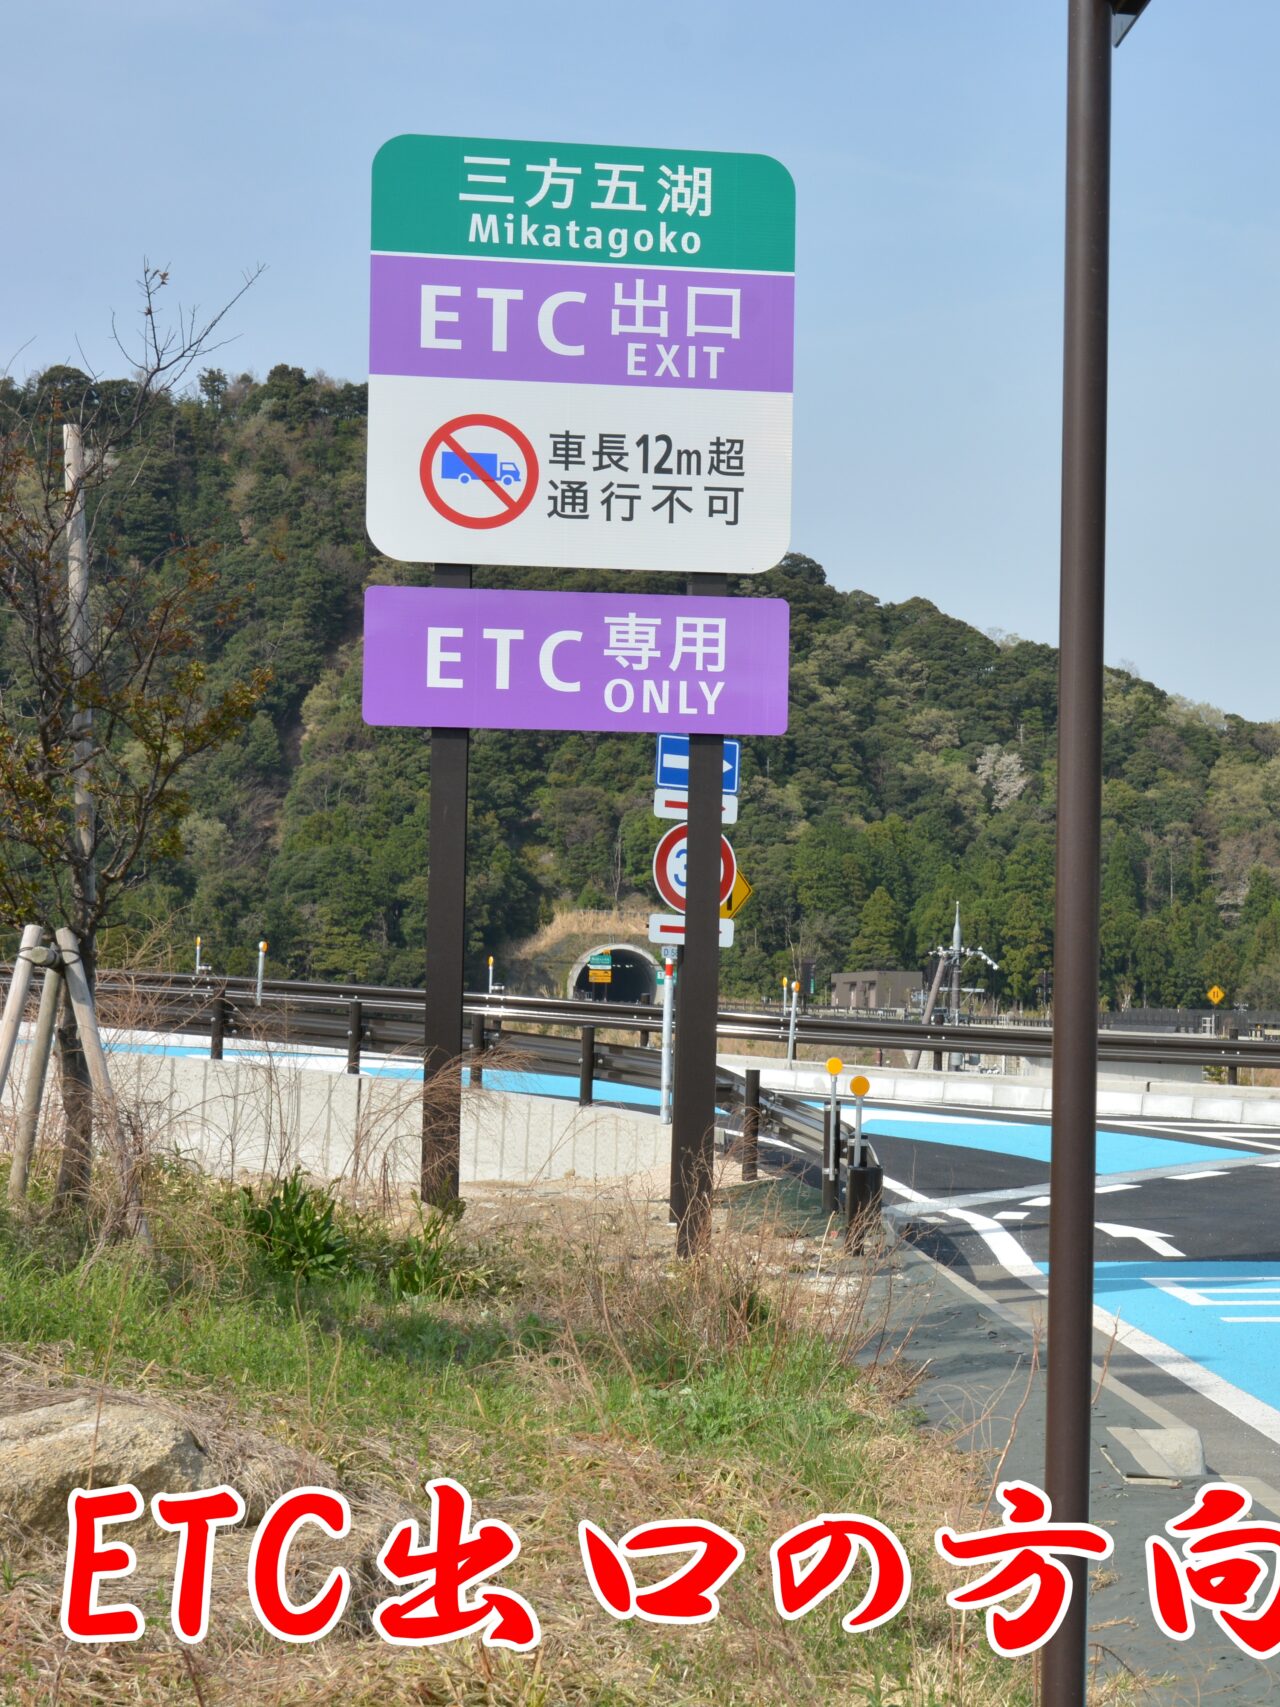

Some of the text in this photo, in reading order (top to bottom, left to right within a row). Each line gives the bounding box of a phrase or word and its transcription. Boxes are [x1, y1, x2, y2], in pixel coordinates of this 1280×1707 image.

[459, 156, 712, 217] 三方五湖
[468, 213, 702, 258] Mikatagoko
[420, 278, 742, 357] ETC 出口
[626, 343, 726, 380] EXIT
[548, 430, 746, 478] 車長12m超
[547, 480, 746, 527] 通行不可
[426, 612, 727, 693] ETC 専用
[603, 678, 726, 716] ONLY
